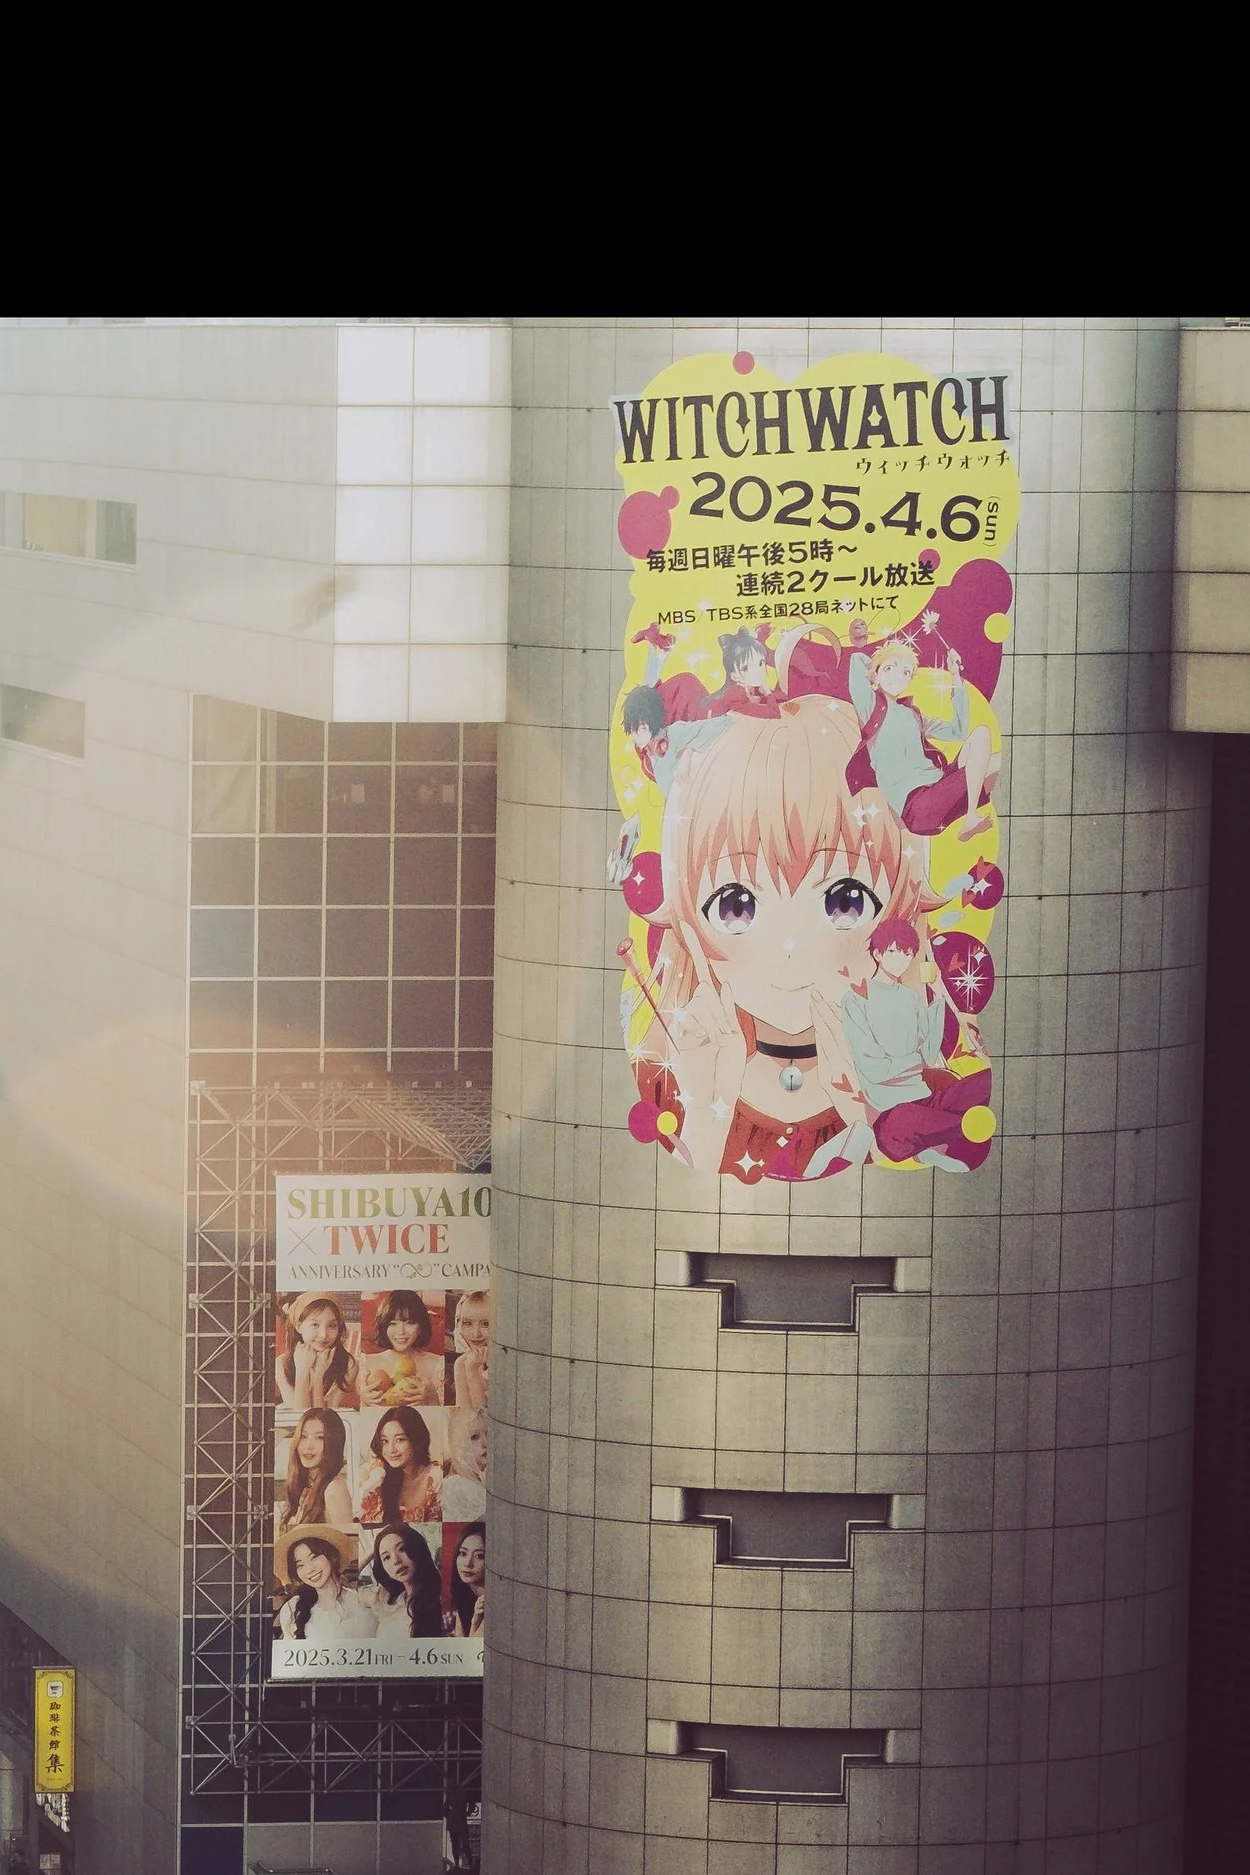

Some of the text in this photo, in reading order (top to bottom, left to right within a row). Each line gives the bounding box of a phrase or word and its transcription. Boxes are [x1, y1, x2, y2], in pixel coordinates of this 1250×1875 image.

[612, 374, 1010, 465] WITCHWATCH
[855, 450, 1012, 475] ウィッチウォッチ
[689, 470, 986, 543] 2025.4.6
[735, 560, 937, 598] 連続2クール放送
[323, 1223, 451, 1256] TWICE
[286, 1263, 391, 1281] ANNIVERSARY
